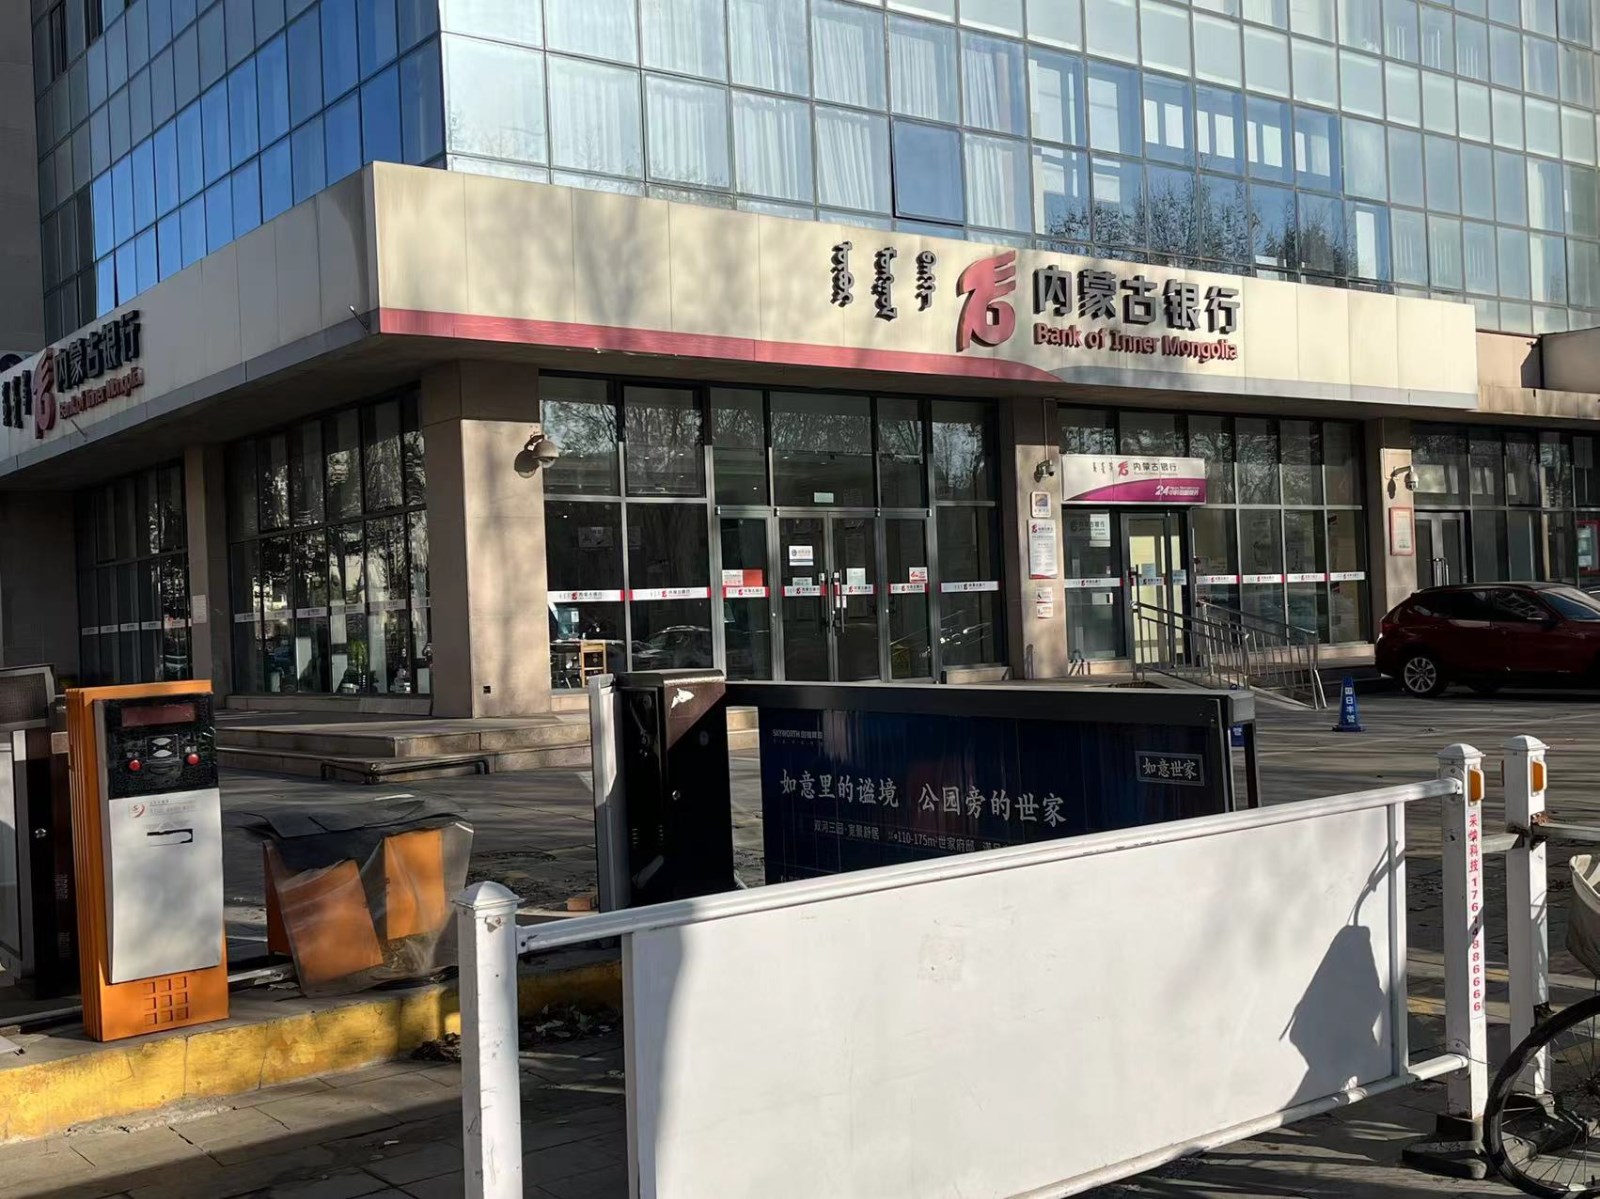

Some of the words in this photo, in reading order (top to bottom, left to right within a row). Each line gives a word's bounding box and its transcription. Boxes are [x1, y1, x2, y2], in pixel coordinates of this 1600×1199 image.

[1033, 265, 1240, 334] 内蒙古银行
[55, 310, 141, 393] 内蒙古银行
[1034, 323, 1084, 347] Bank
[1085, 328, 1108, 349] of
[1109, 329, 1160, 354] Inner
[1161, 336, 1238, 364] Mongolia
[1133, 462, 1178, 472] 内蒙古银行
[1142, 757, 1198, 779] 如意世家
[780, 768, 899, 808] 如意里的谧境
[918, 783, 1067, 828] 公园旁的世家
